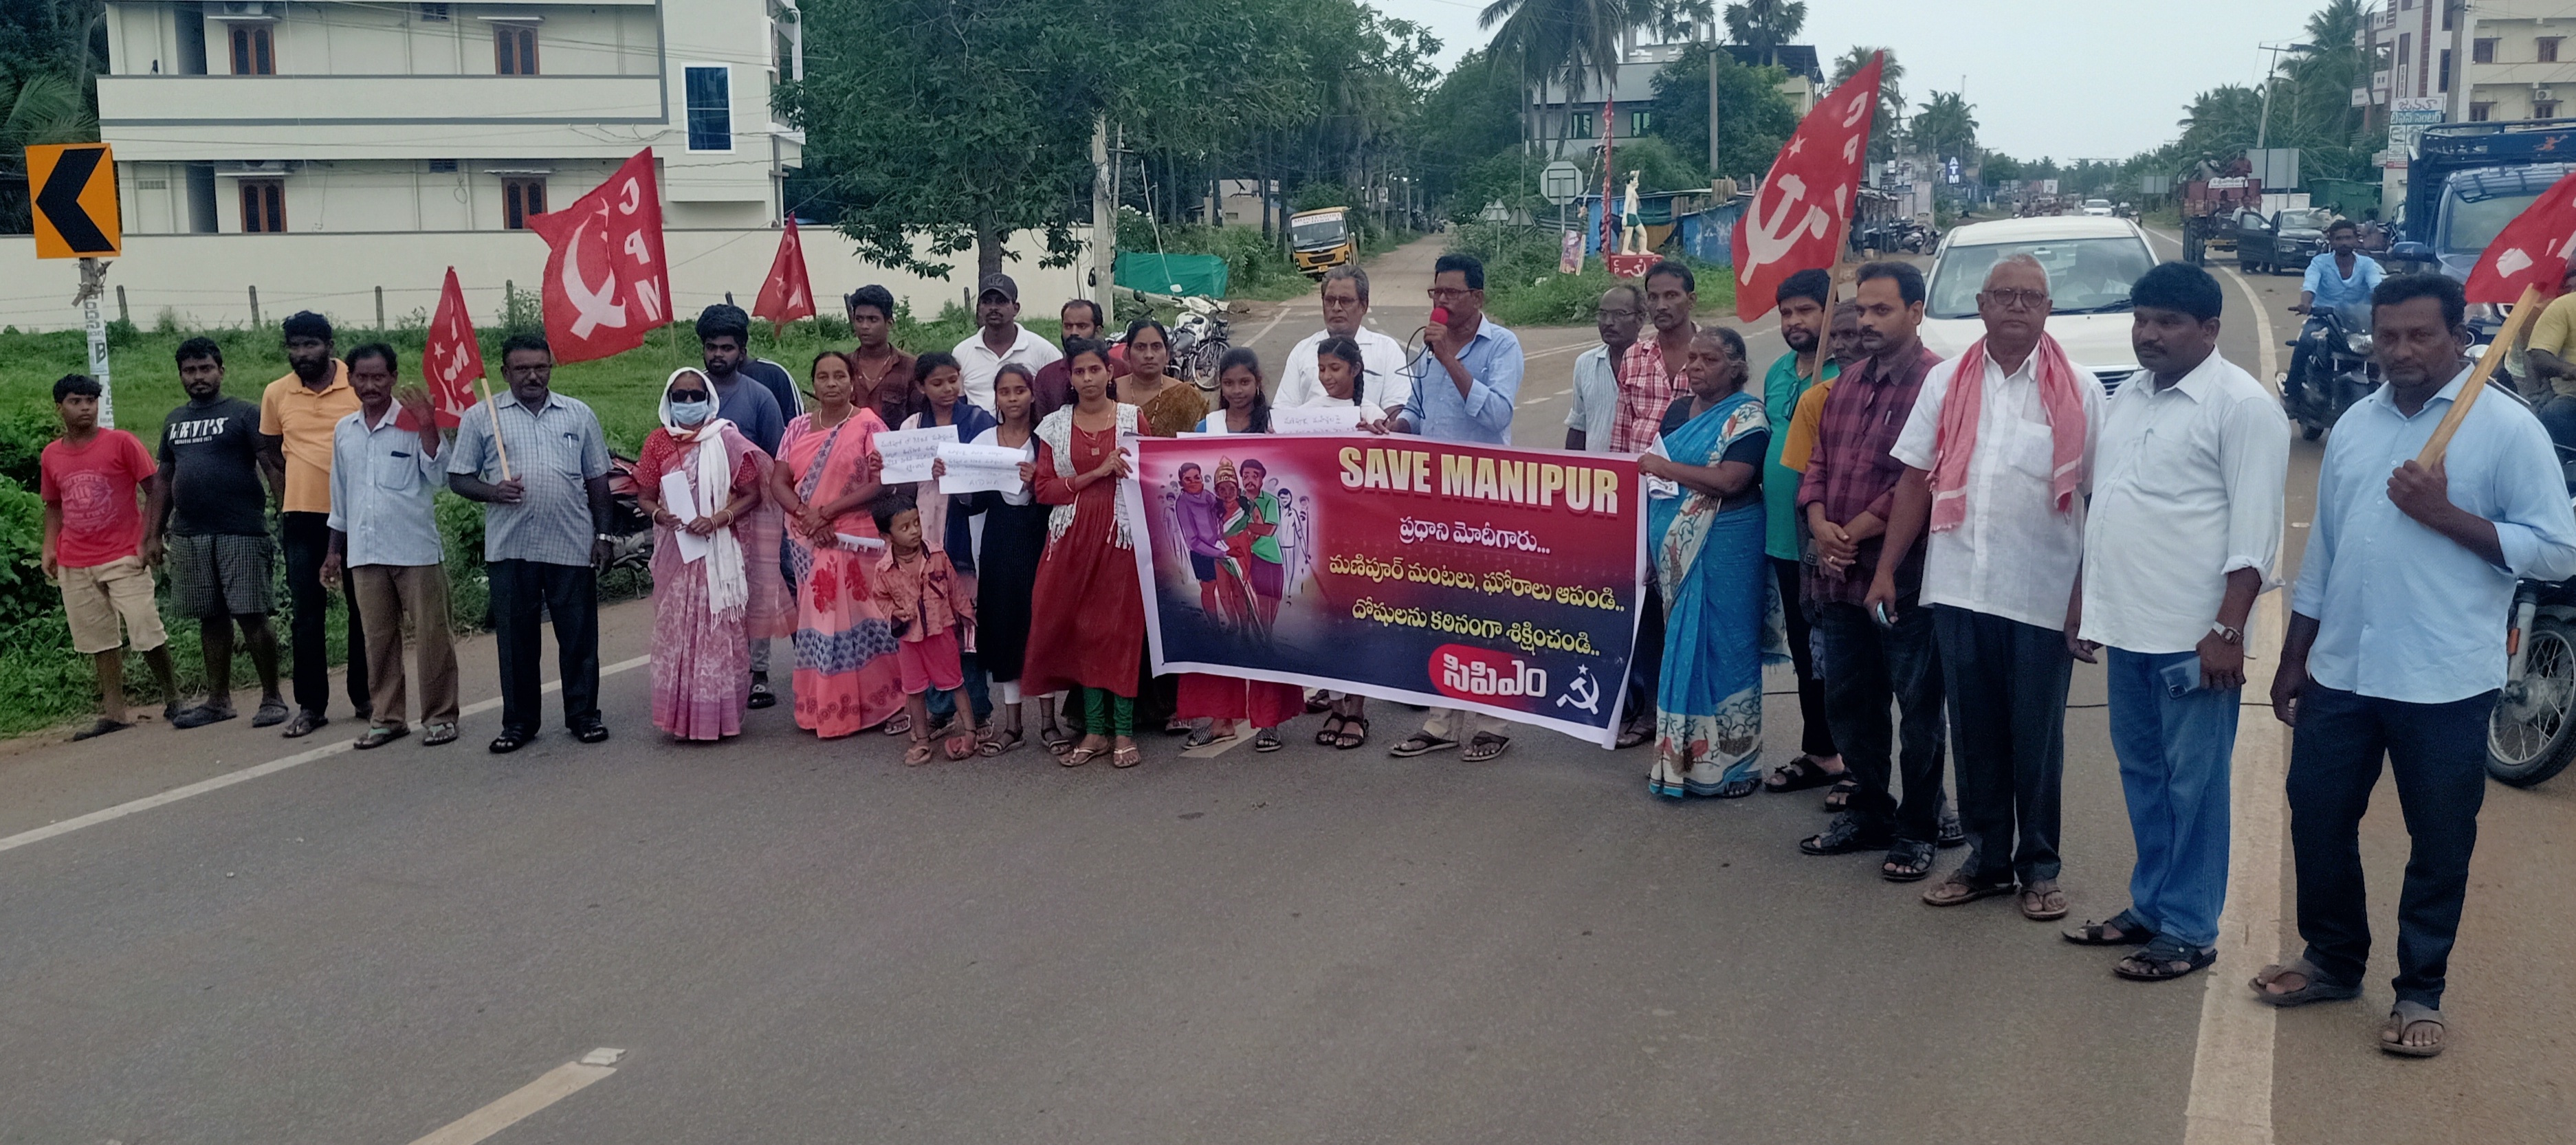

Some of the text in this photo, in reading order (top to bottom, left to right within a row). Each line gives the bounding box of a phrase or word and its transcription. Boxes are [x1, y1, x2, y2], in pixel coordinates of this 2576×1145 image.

[1948, 157, 1959, 184] ATM
[1339, 447, 1618, 515] SAVE MANIPUR
[1399, 516, 1550, 554] ప్రధాని మోదీగారు...
[1329, 553, 1625, 612] మణిపూర్ మంటలు, ఘోరాలు ఆపండి..
[1352, 596, 1428, 627] దోషులను
[1443, 653, 1547, 697] సిపిఎం
